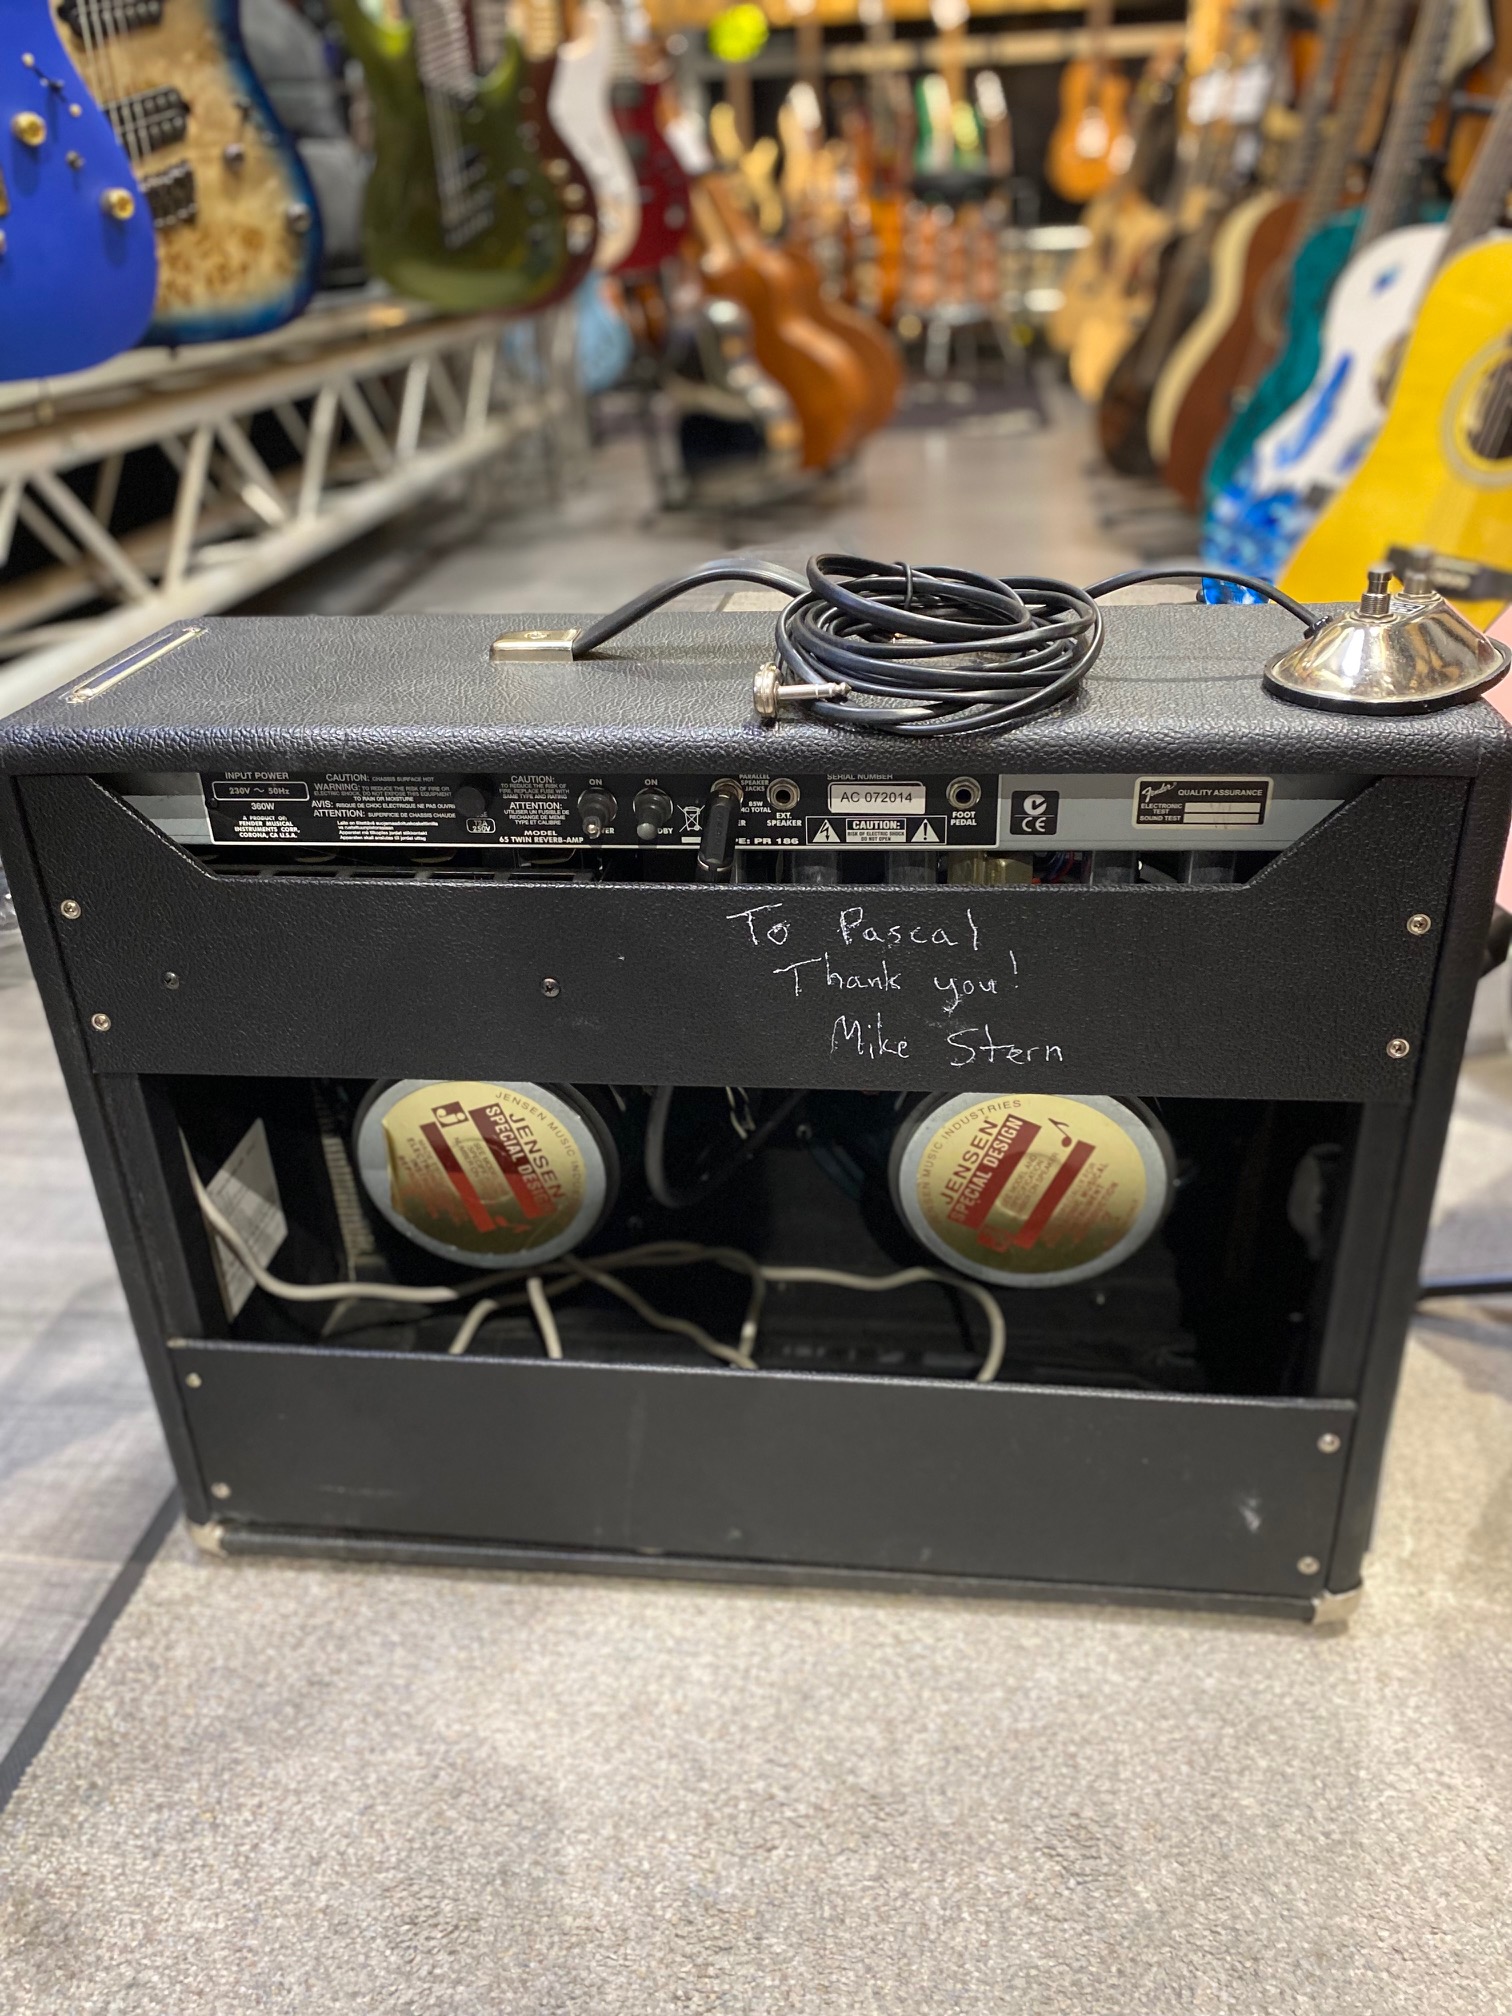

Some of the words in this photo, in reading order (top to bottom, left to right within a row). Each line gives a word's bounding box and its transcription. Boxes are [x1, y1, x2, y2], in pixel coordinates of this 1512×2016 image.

[840, 792, 860, 803] AC
[864, 792, 913, 803] 072014
[853, 820, 900, 830] CAUTION:
[726, 902, 791, 946] To
[838, 906, 981, 951] Pascal
[773, 952, 902, 997] Thank
[934, 950, 1019, 1014] you!
[830, 1012, 910, 1059] Mike
[946, 1024, 1064, 1067] Stern
[486, 1106, 524, 1162] SPECIAL
[496, 1092, 548, 1121] JENSEN
[547, 1122, 576, 1158] MUSIC
[508, 1113, 566, 1199] JENSEN
[922, 1142, 943, 1178] MUSIC
[942, 1099, 1021, 1140] INDUSTRIES
[941, 1119, 998, 1206] JENSEN
[949, 1171, 992, 1220] SPECIAL
[983, 1116, 1024, 1168] DESIGN
